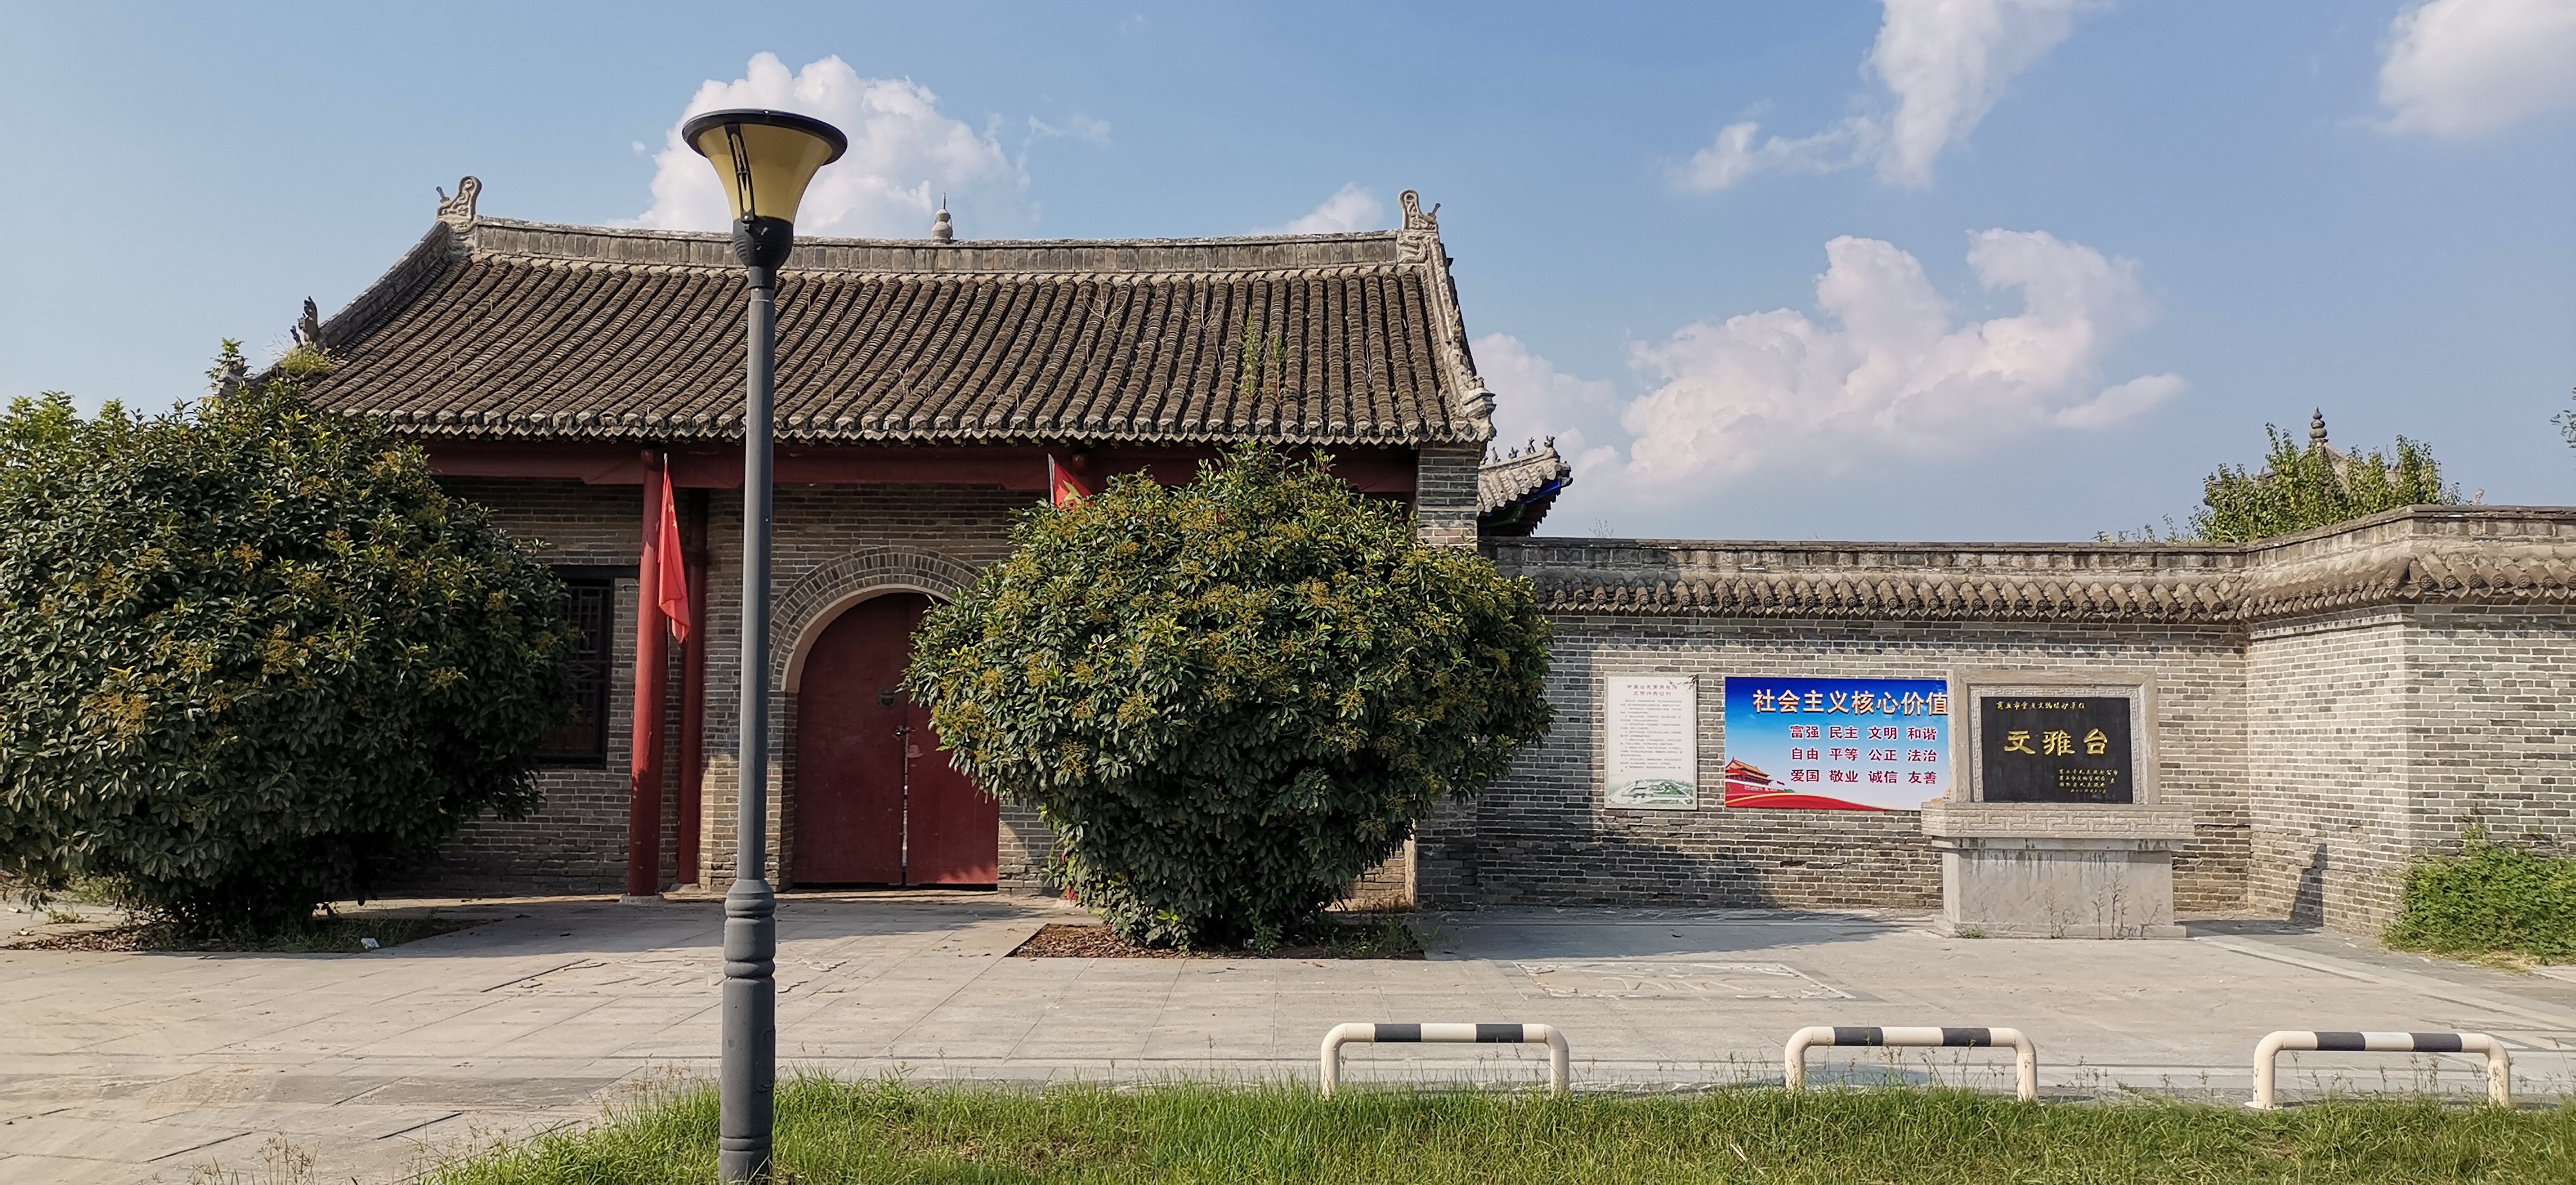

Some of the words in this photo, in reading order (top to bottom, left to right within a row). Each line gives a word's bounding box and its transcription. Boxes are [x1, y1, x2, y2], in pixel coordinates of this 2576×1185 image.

[1753, 688, 1948, 716] 社会主义核心价值
[1790, 725, 1821, 741] 富强
[1828, 726, 1859, 741] 民主
[1868, 726, 1898, 741] 文明
[1907, 726, 1938, 742] 和谐
[2003, 728, 2108, 757] 文雅台
[1791, 747, 1819, 761] 自由
[1829, 747, 1859, 762] 平等
[1868, 748, 1898, 763] 公正
[1907, 748, 1938, 763] 法治
[1790, 769, 1820, 782] 爱国
[1829, 769, 1859, 784] 敬业
[1868, 770, 1899, 784] 诚信
[1908, 770, 1938, 785] 友善
